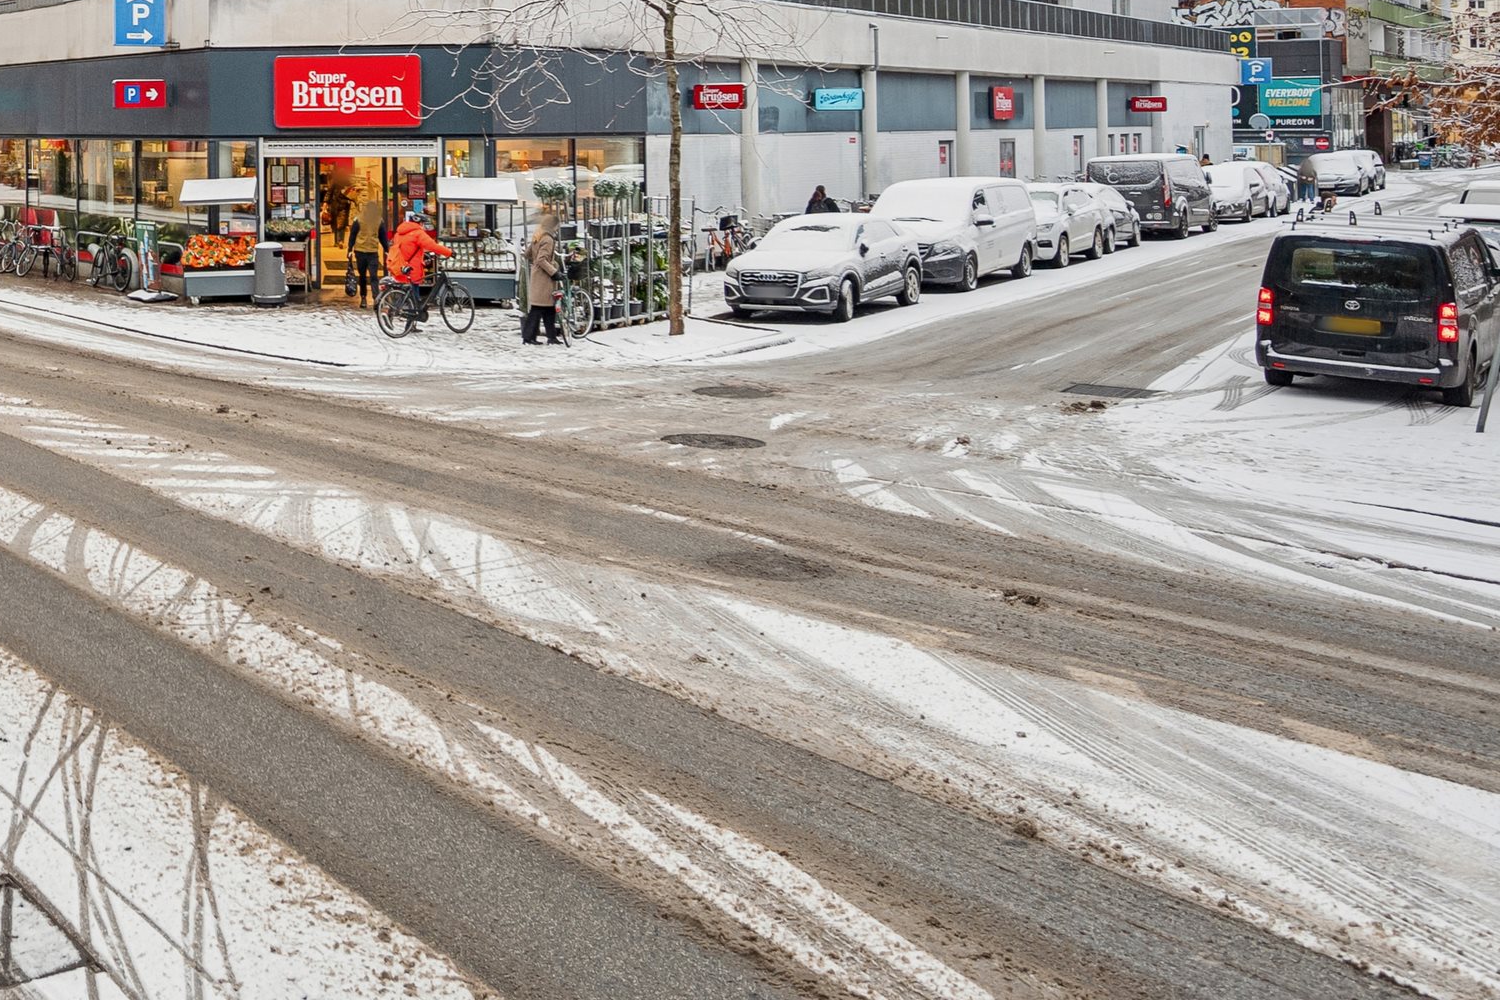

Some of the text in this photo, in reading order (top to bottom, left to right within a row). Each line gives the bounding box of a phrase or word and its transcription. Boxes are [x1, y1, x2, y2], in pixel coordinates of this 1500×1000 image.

[132, 3, 150, 26] P
[1251, 65, 1262, 76] P
[308, 70, 347, 87] Super
[127, 88, 136, 101] P
[291, 80, 403, 114] Brugsen
[1265, 88, 1315, 98] EVERYBODY
[1267, 97, 1312, 107] WELCOME
[1275, 118, 1315, 126] PUREGYM
